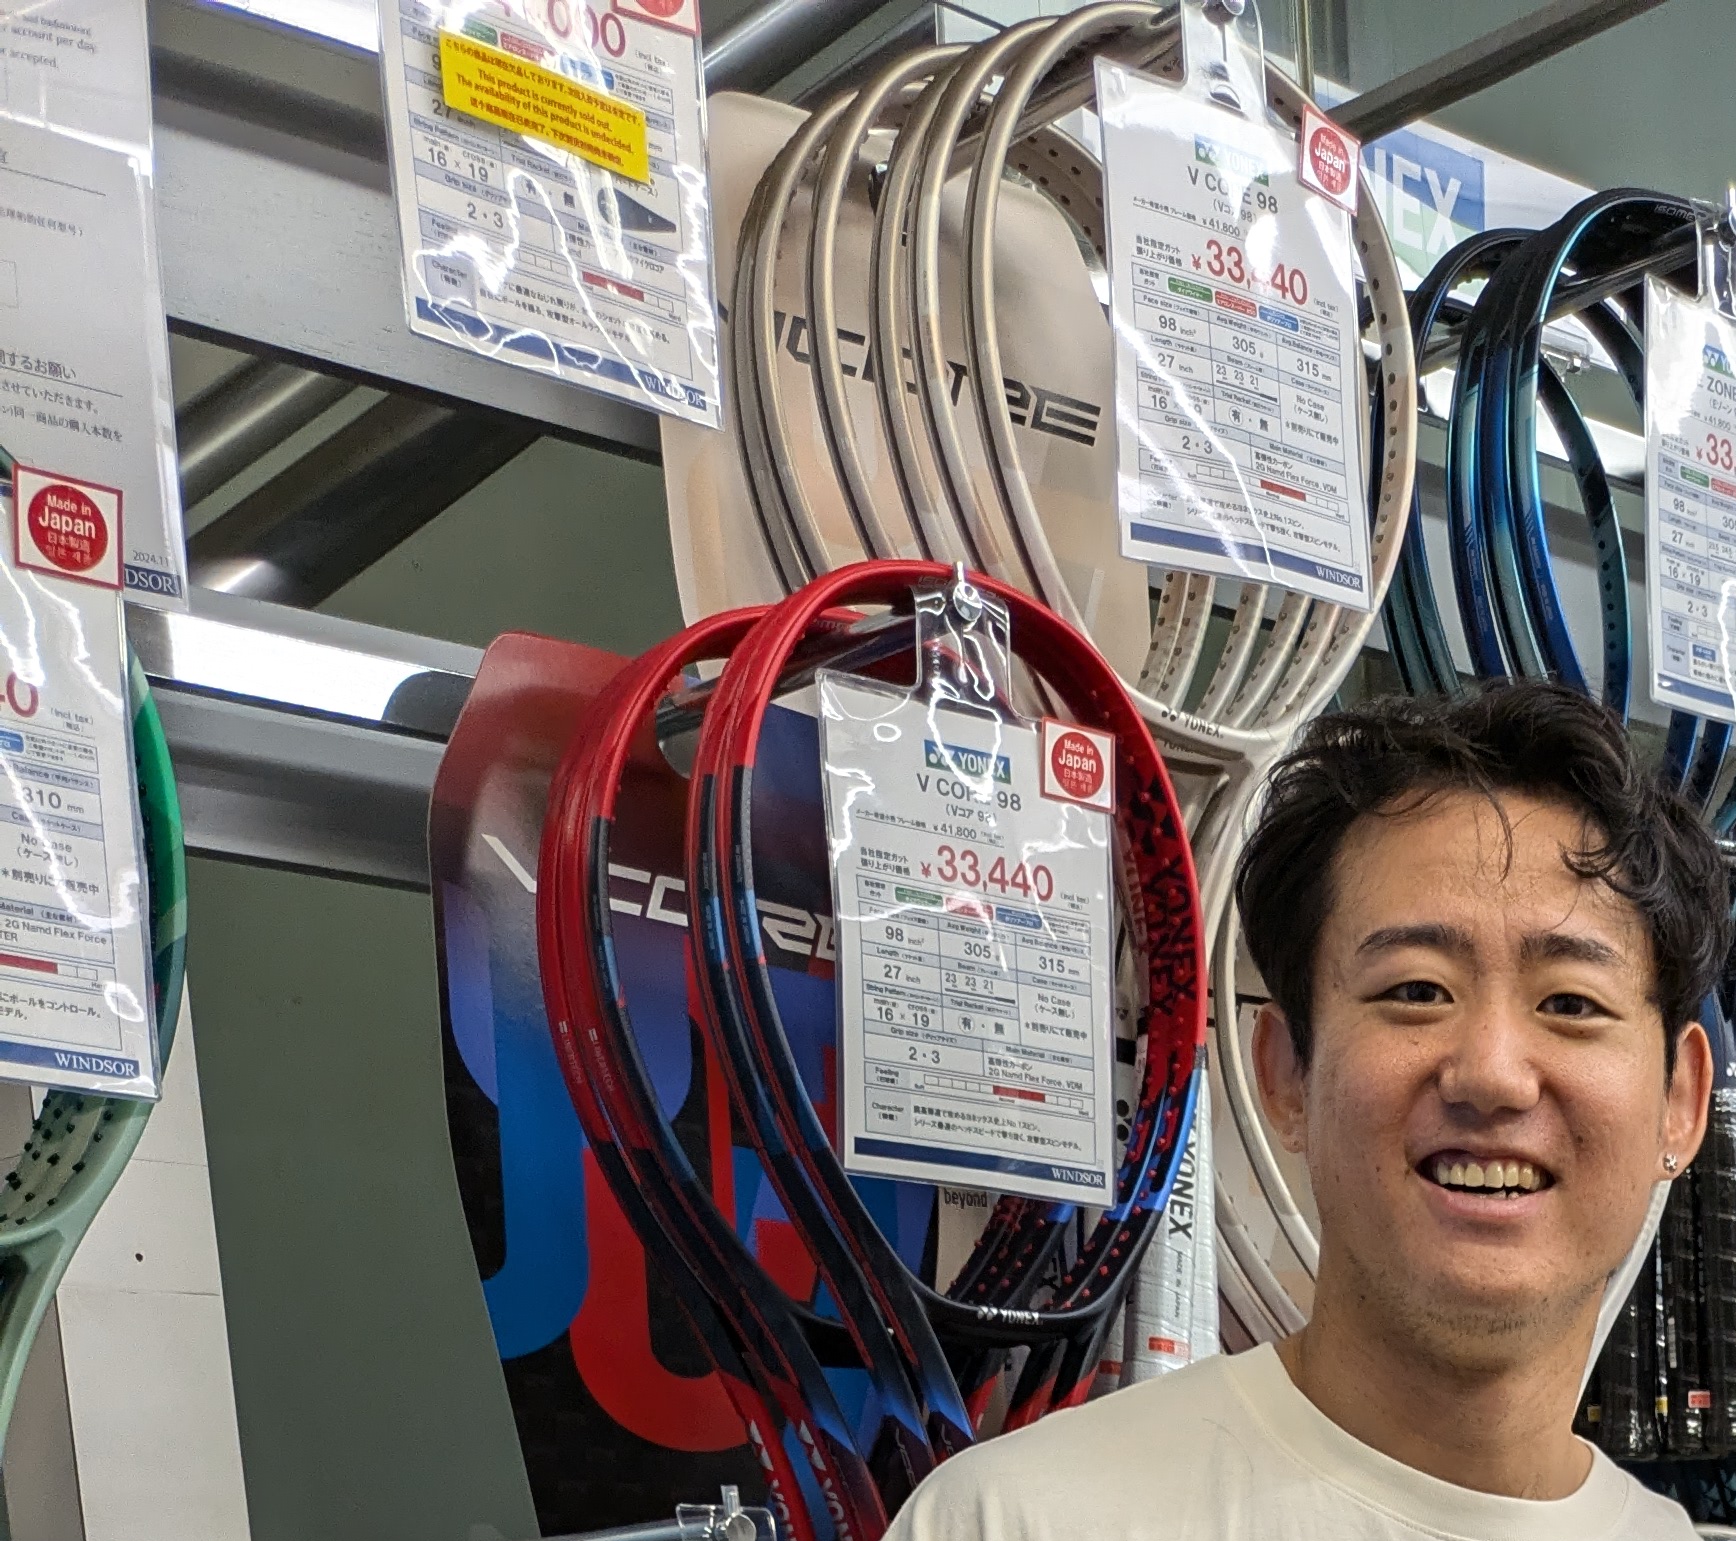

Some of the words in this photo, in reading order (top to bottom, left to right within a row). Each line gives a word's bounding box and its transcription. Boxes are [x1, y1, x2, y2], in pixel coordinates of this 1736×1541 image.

[56, 35, 74, 48] per
[457, 73, 473, 88] The
[474, 81, 521, 108] availability
[533, 104, 549, 118] this
[550, 112, 582, 135] product
[478, 69, 496, 85] This
[497, 76, 532, 99] product
[541, 92, 577, 118] currently
[579, 109, 596, 126] sold
[428, 147, 447, 168] 16
[469, 162, 489, 183] 19
[1315, 144, 1346, 173] Japan
[1187, 166, 1199, 186] V
[1257, 191, 1279, 215] 98
[1158, 314, 1177, 333] 98
[1232, 335, 1257, 356] 305
[1296, 357, 1320, 378] 315
[1157, 352, 1176, 370] 27
[1215, 363, 1228, 378] 23
[47, 494, 78, 513] Made
[81, 501, 92, 516] in
[1673, 497, 1686, 513] 98
[38, 506, 96, 539] Japan
[1672, 530, 1684, 545] 27
[132, 549, 170, 567] 2024.11
[1315, 564, 1363, 590] WINDSOR
[1668, 565, 1680, 579] 16
[1689, 572, 1702, 587] 19
[1064, 738, 1086, 755] Made
[1087, 745, 1095, 757] in
[1058, 750, 1097, 774] Japan
[916, 773, 930, 793] V
[997, 789, 1022, 812] 98
[20, 832, 39, 847] No
[5, 917, 22, 931] 2G
[23, 921, 53, 936] Namd
[54, 925, 76, 941] Flex
[77, 929, 108, 946] Force
[884, 925, 904, 943] 98
[964, 941, 992, 959] 305
[1038, 956, 1066, 975] 315
[883, 964, 902, 981] 27
[945, 971, 957, 986] 23
[964, 975, 977, 989] 23
[983, 978, 994, 992] 21
[876, 1006, 894, 1022] 16
[912, 1012, 930, 1028] 19
[54, 1052, 137, 1077] WINDSOR
[1051, 1165, 1104, 1188] WINDSOR
[943, 1189, 988, 1210] beyond
